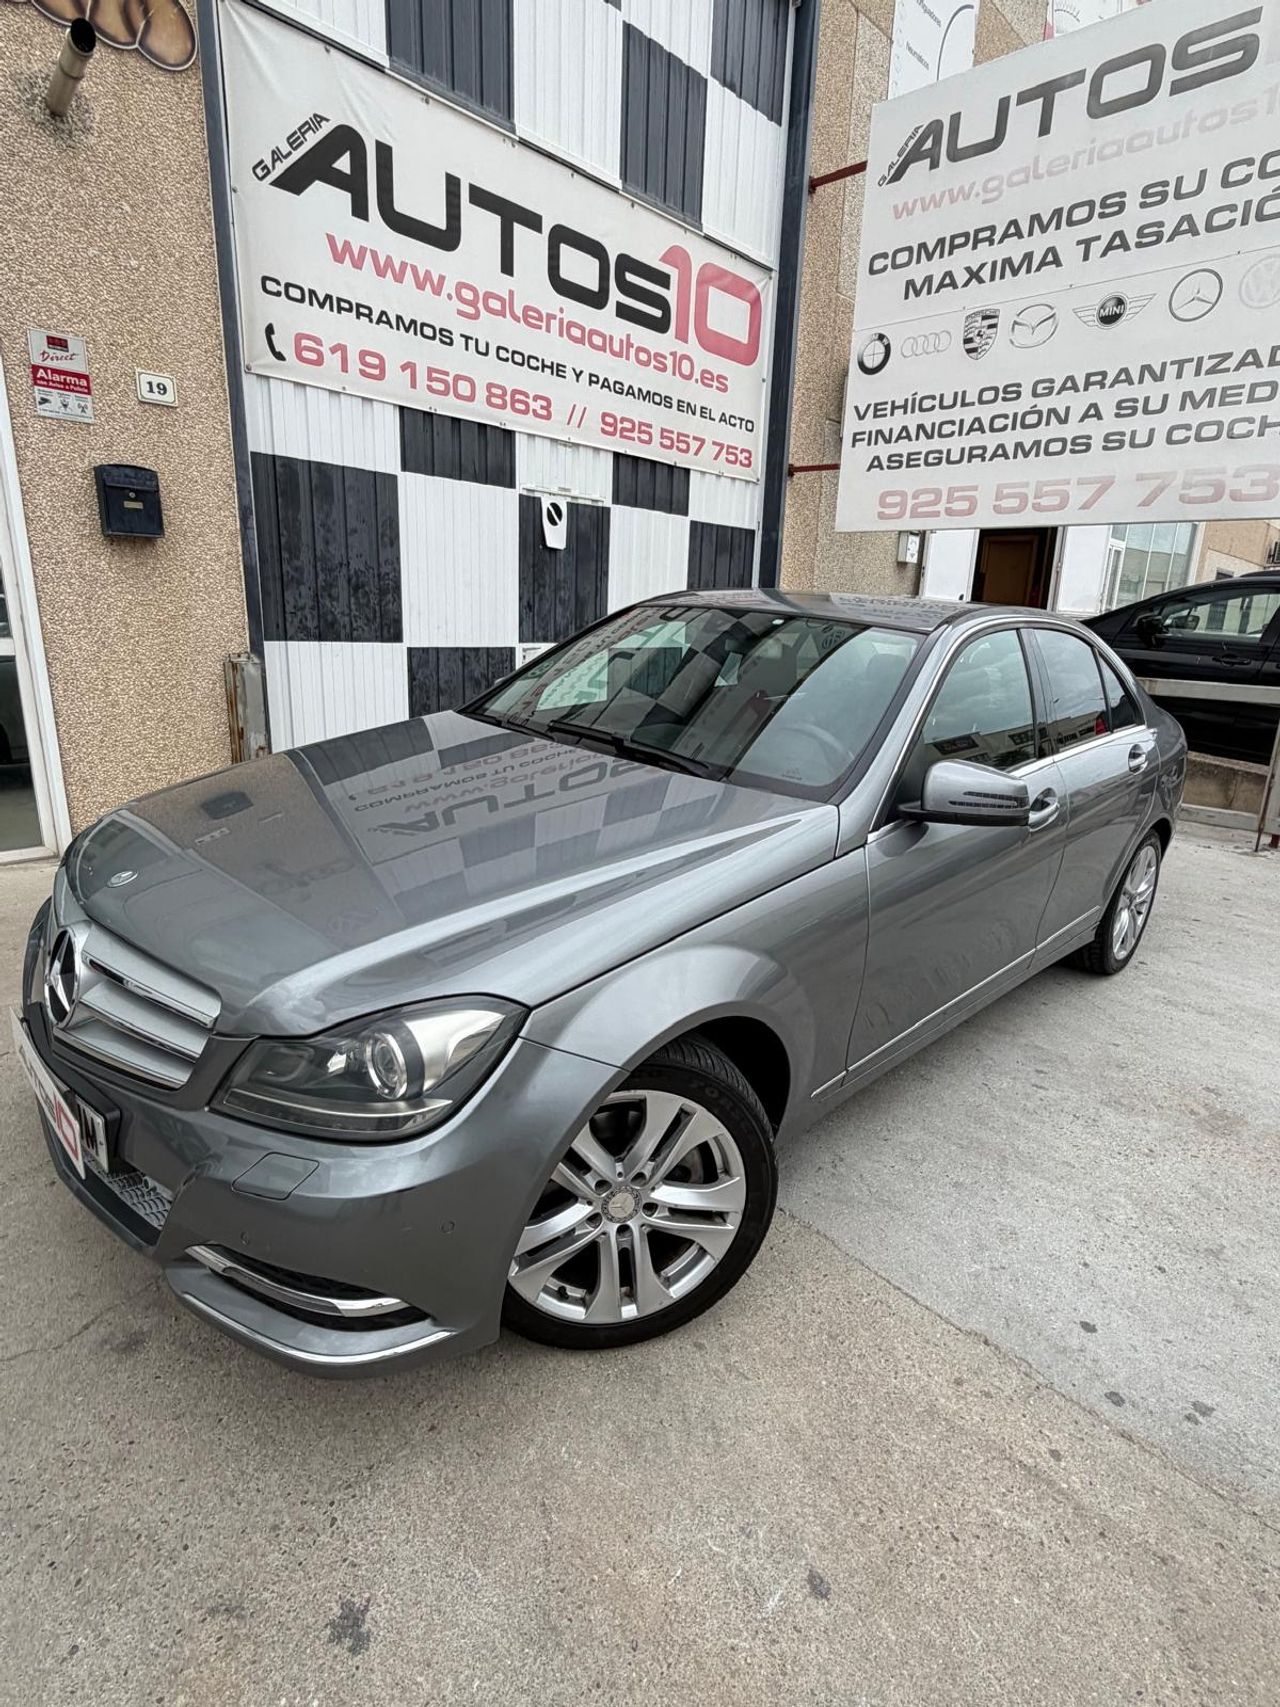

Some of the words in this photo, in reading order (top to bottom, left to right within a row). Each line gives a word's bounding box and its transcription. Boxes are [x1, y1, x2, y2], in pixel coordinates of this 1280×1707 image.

[251, 112, 331, 182] GALERIA
[877, 124, 925, 187] GALERIA
[868, 191, 1127, 276] COMPRAMOS
[1139, 167, 1208, 209] SU
[1220, 149, 1280, 189] CO
[903, 244, 1064, 301] MAXIMA
[1076, 184, 1280, 263] TASACIÓ
[326, 233, 729, 394] www.galeriaautos10.es
[1099, 304, 1125, 317] MINI
[36, 368, 88, 387] Alarma
[260, 275, 455, 347] COMPRAMOS
[460, 334, 490, 357] TU
[495, 345, 567, 379] COCHE
[572, 367, 584, 383] Y
[588, 373, 673, 409] PAGAMOS
[676, 399, 697, 416] EN
[699, 406, 716, 422] EL
[718, 412, 755, 433] ACTO
[147, 381, 168, 396] 19
[293, 332, 387, 383] 619
[399, 361, 477, 404] 150
[485, 382, 553, 423] 863
[600, 411, 654, 447] 925
[658, 427, 706, 458] 557
[711, 440, 753, 469] 753
[851, 405, 1071, 449] FINANCIACIÓN
[1078, 402, 1104, 424] A
[1114, 393, 1169, 420] SU
[1179, 380, 1280, 412] MED
[853, 382, 1023, 422] VEHÍCULOS
[866, 434, 1093, 473] ASEGURAMOS
[1101, 427, 1156, 452] SU
[877, 485, 979, 521] 925
[992, 475, 1116, 514] 557
[1135, 463, 1280, 508] 753
